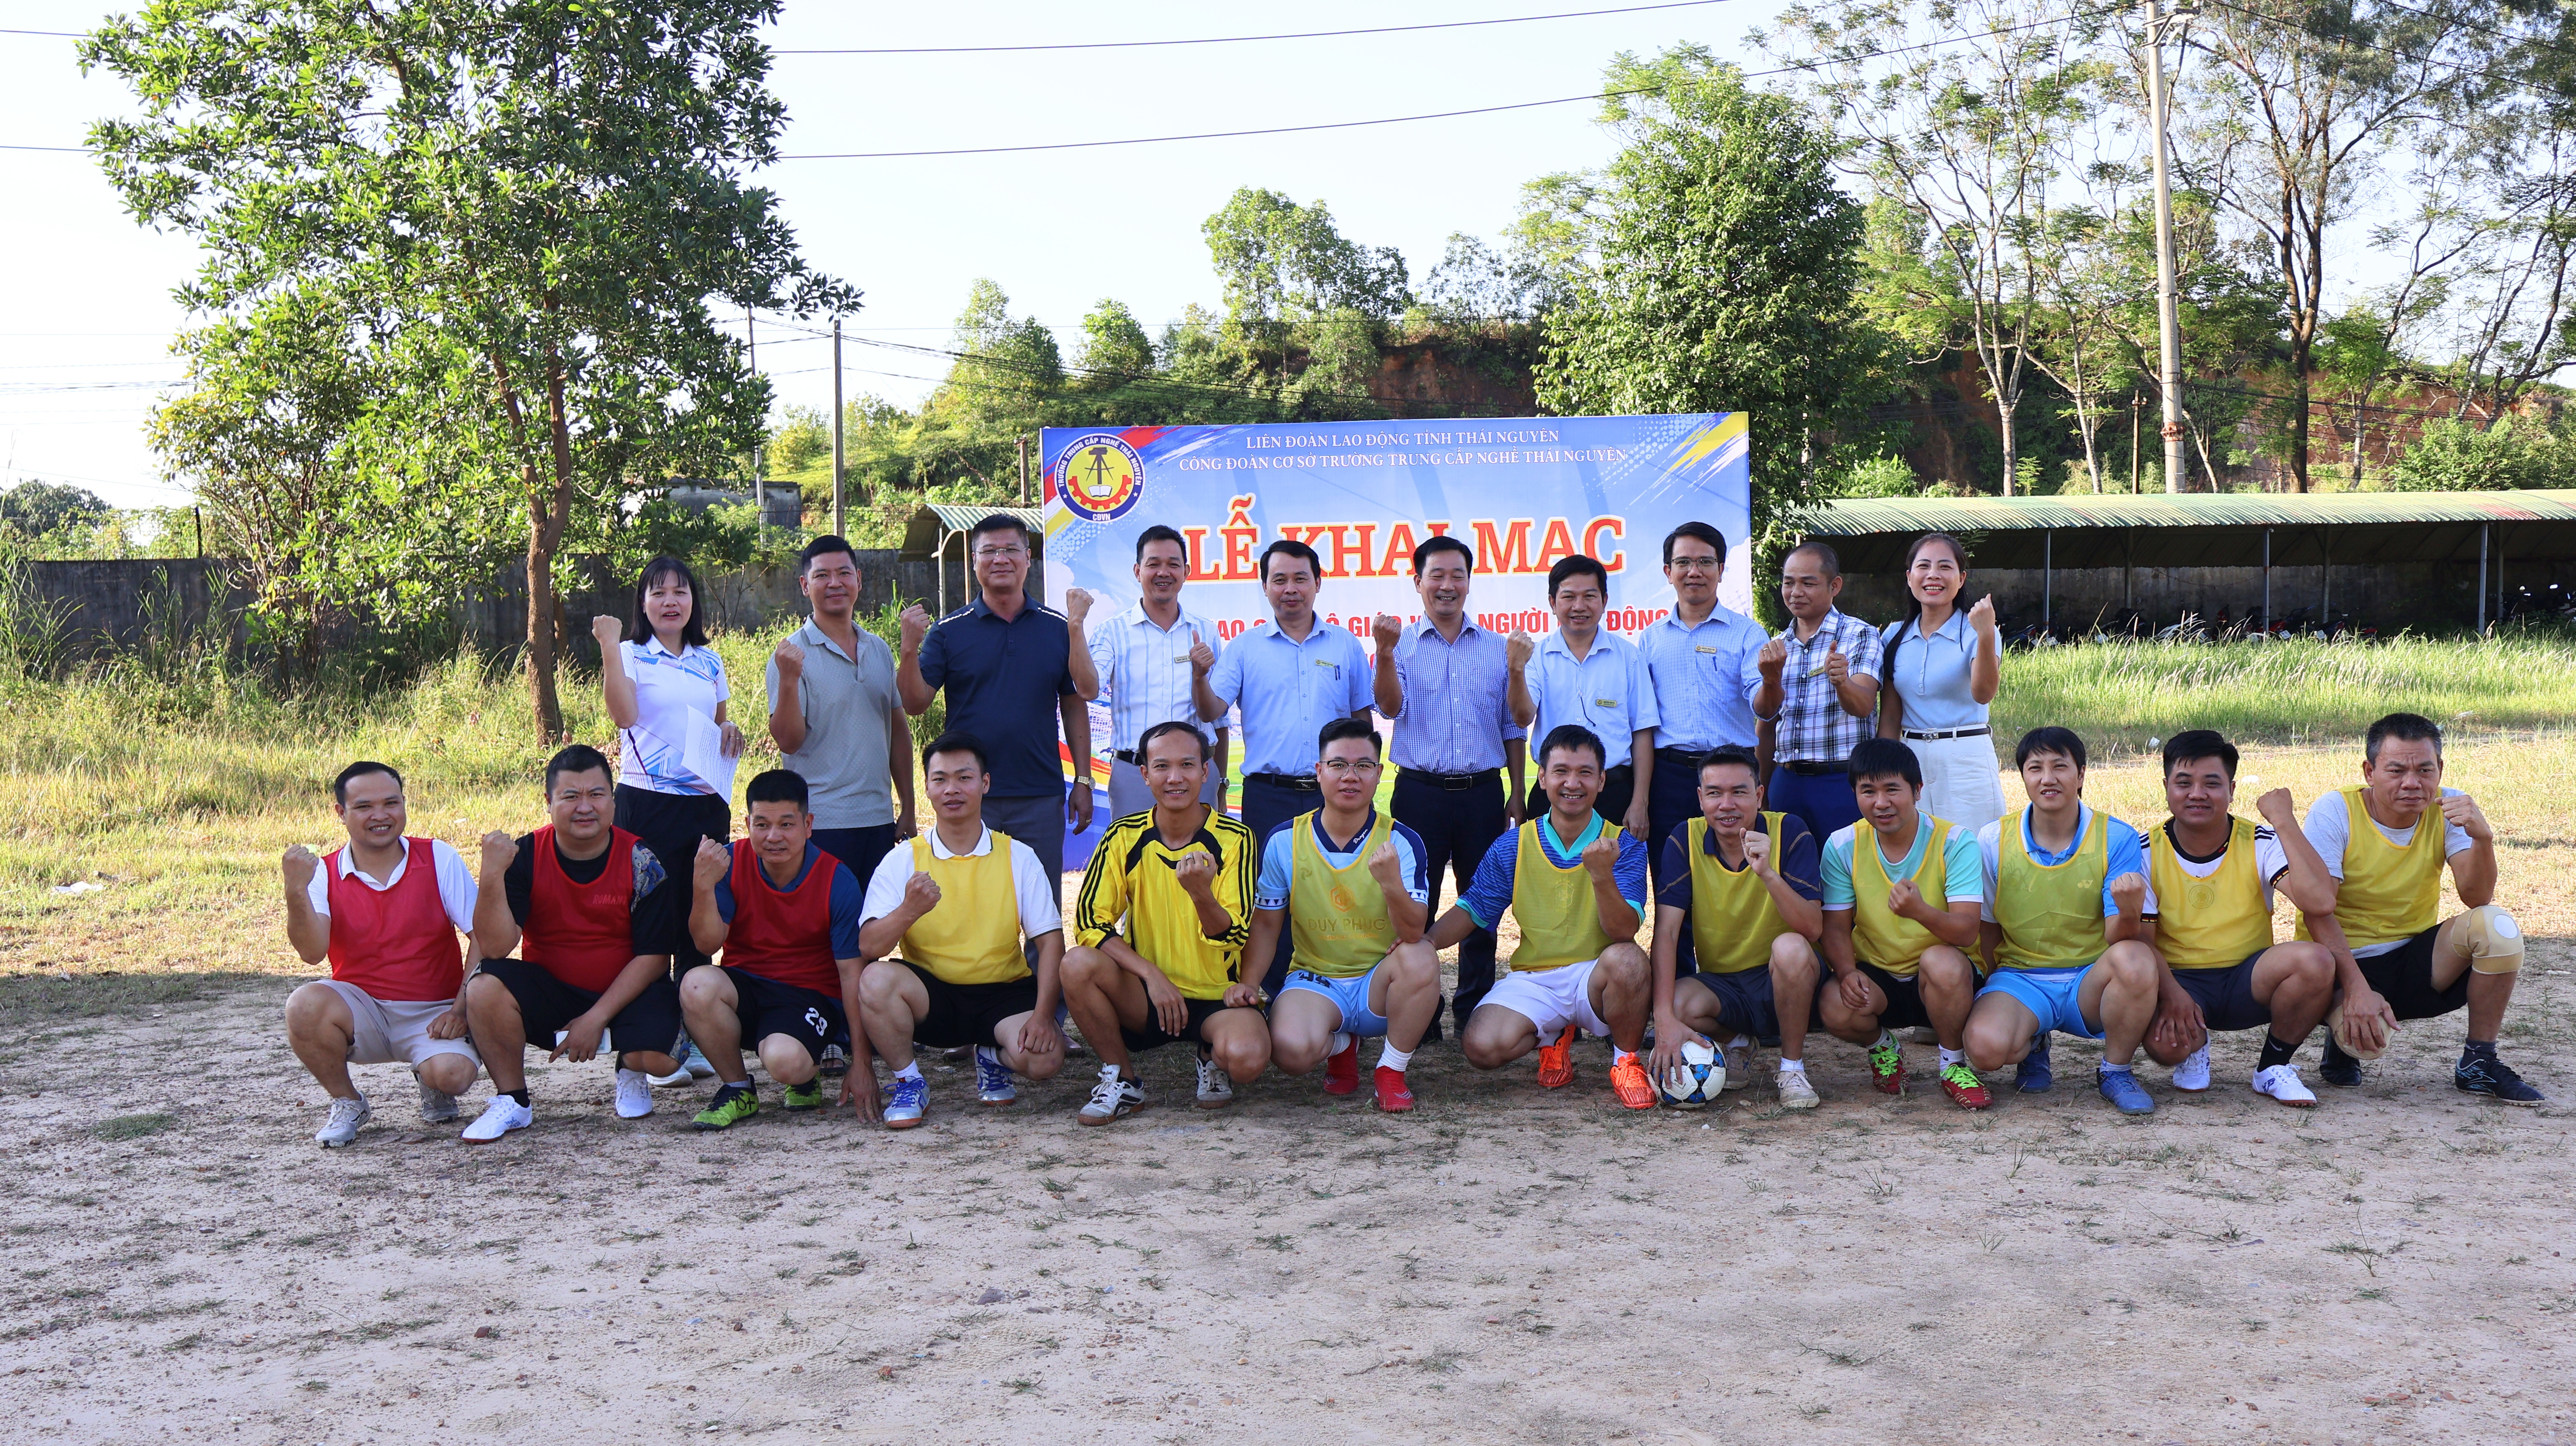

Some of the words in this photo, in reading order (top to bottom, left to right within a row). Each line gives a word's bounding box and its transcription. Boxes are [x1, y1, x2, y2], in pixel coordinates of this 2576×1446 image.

[1246, 434, 1281, 449] LIÊN
[1285, 432, 1328, 447] ĐOÀN
[1331, 434, 1362, 447] LAO
[1365, 431, 1410, 449] ĐỘNG
[1414, 428, 1452, 445] TỈNH
[1455, 428, 1493, 444] THÁI
[1496, 427, 1559, 443] NGUYÊN
[1058, 460, 1068, 488] TRƯỜNG
[1064, 442, 1084, 459] TRUNG
[1084, 436, 1099, 446] CẤP
[1120, 444, 1133, 459] THÁI
[1130, 459, 1142, 486] NGUYÊN
[1179, 456, 1222, 471] CÔNG
[1226, 454, 1269, 469] ĐOÀN
[1272, 456, 1294, 468] CƠ
[1297, 452, 1317, 468] SỞ
[1319, 452, 1384, 467] TRƯỜNG
[1388, 453, 1441, 466] TRUNG
[1445, 447, 1473, 465] CẤP
[1476, 445, 1519, 464] NGHỀ
[1522, 447, 1560, 463] THÁI
[1563, 446, 1627, 462] NGUYÊN
[1182, 495, 1260, 582] LỄ
[1212, 620, 1245, 641] AO
[1348, 611, 1402, 637] GI
[1478, 608, 1548, 633] NGƯỜI
[1353, 829, 1368, 844] Dragon
[1307, 918, 1338, 932] DUY
